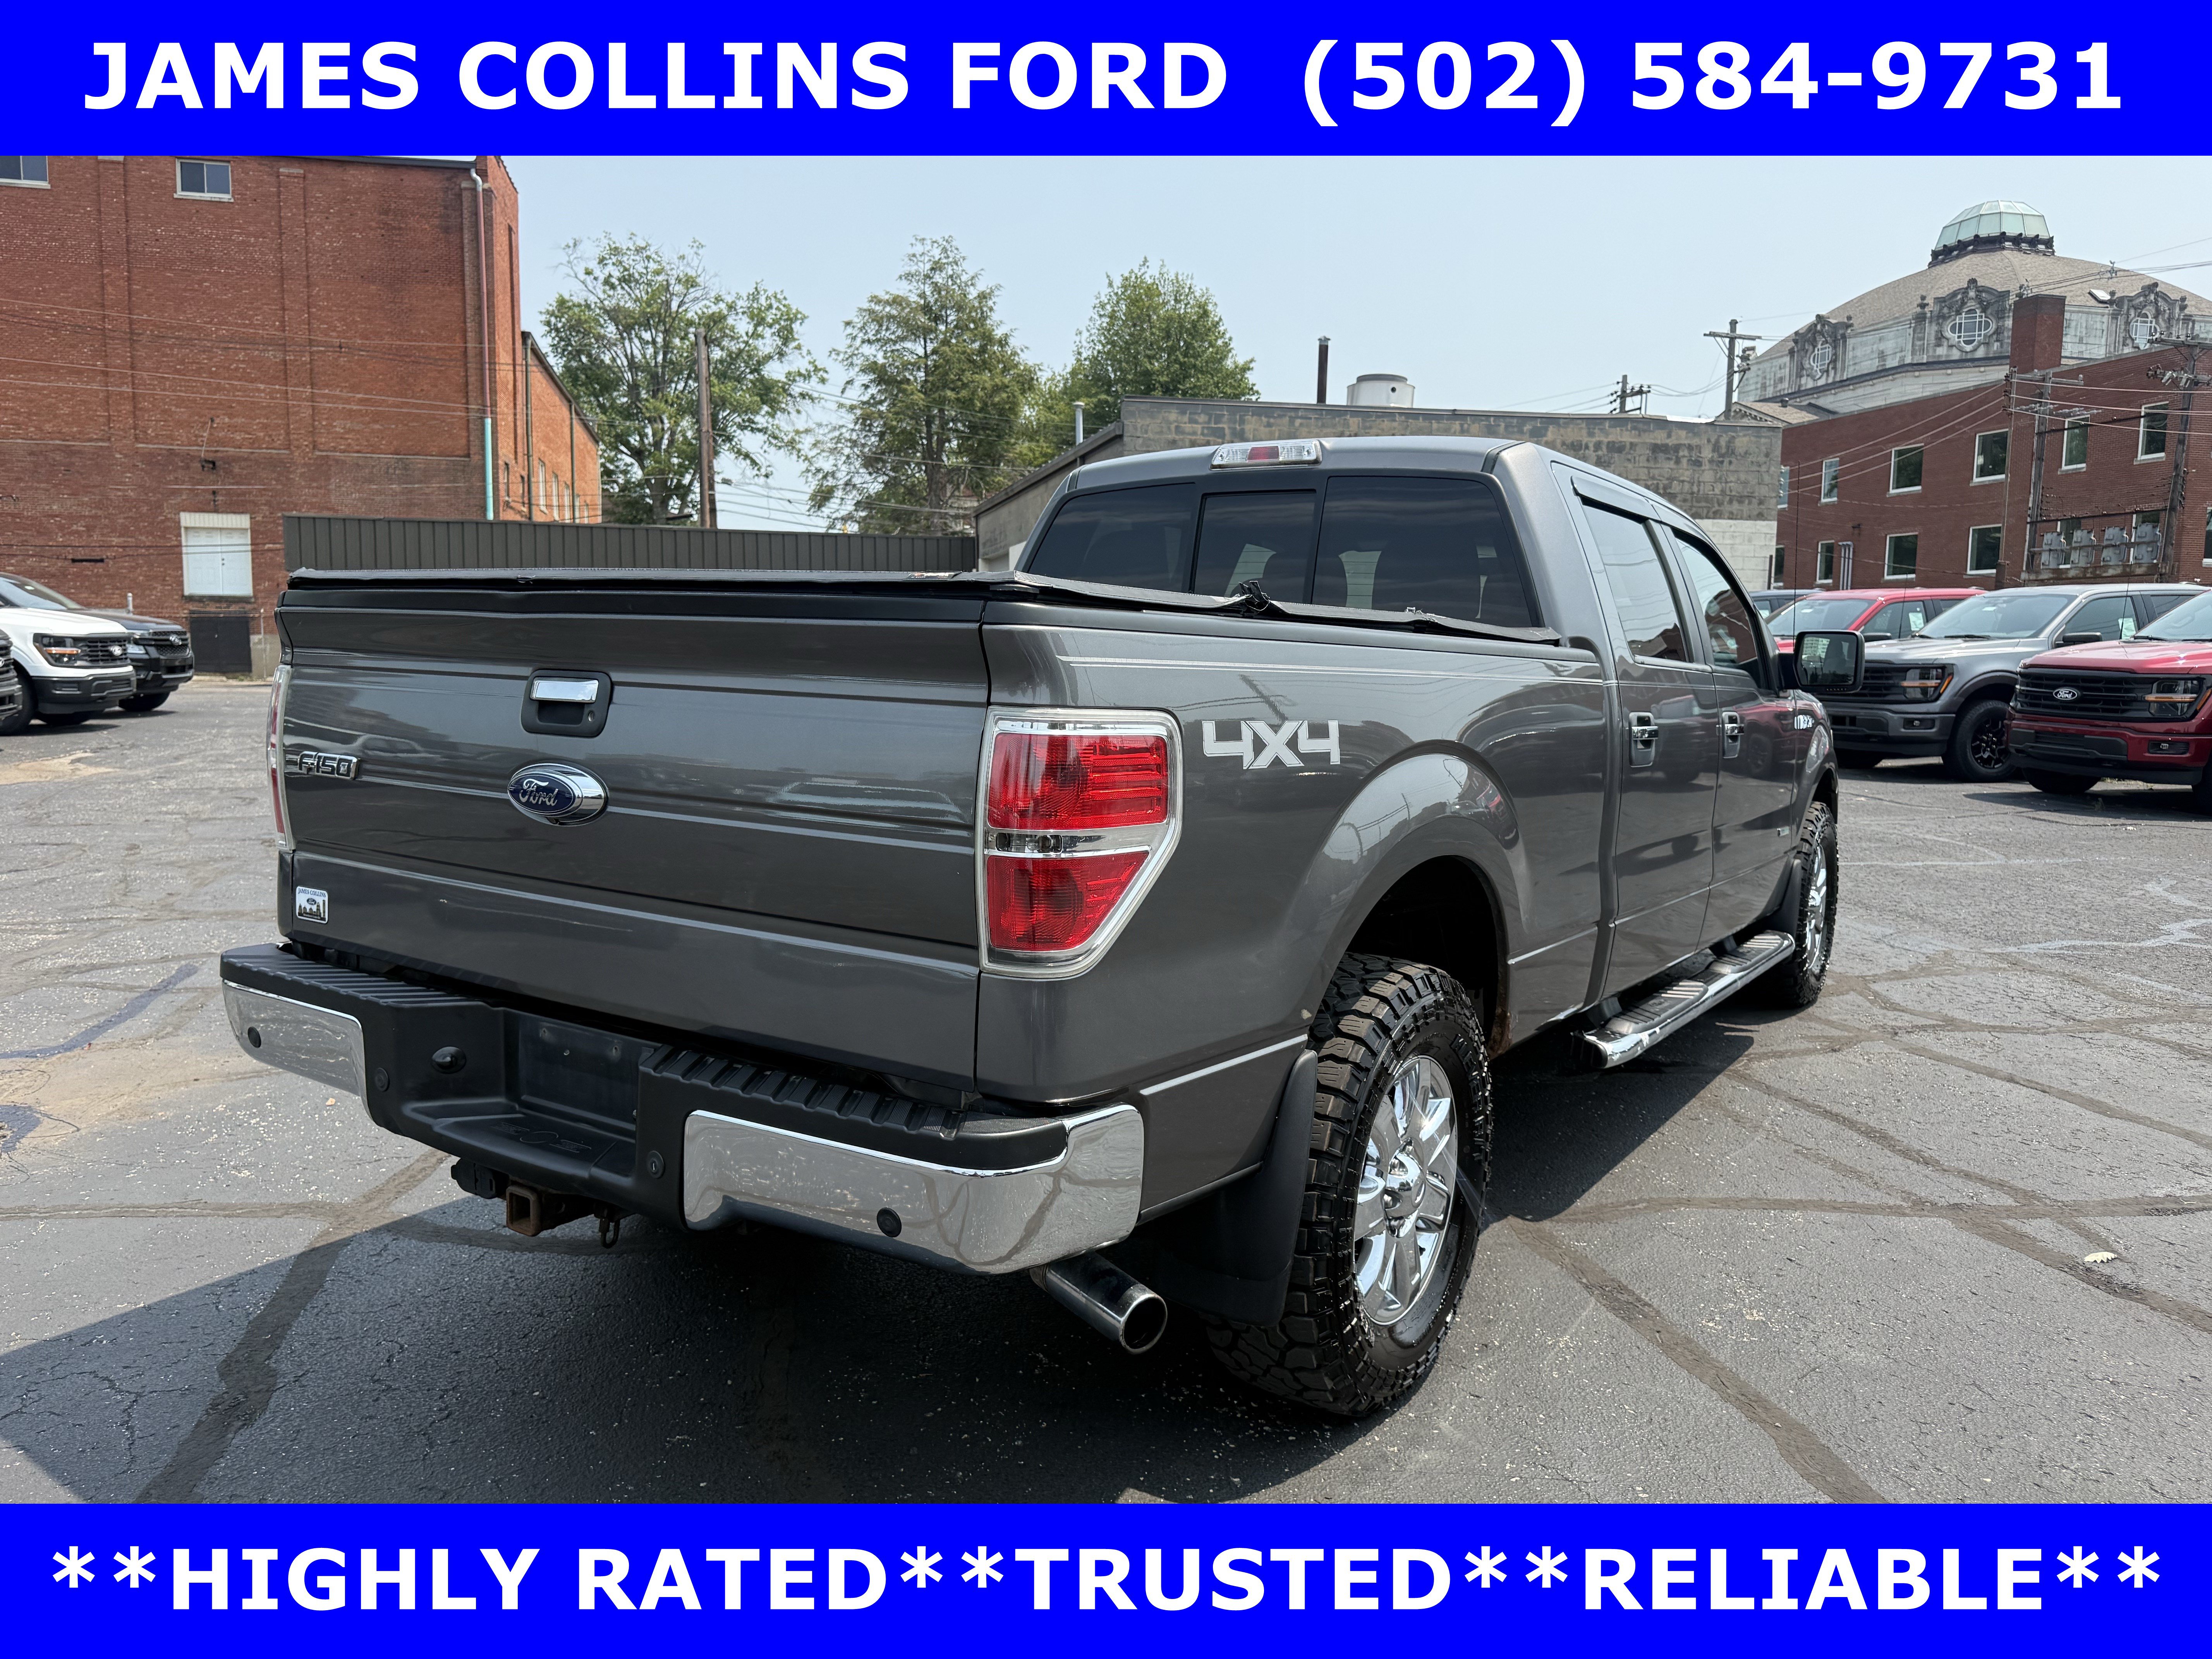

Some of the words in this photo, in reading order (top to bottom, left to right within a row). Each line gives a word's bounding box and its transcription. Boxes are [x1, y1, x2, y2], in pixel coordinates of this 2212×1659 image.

[1202, 720, 1340, 769] 4X4
[519, 778, 559, 806] Ford
[310, 890, 326, 898] COLLINS
